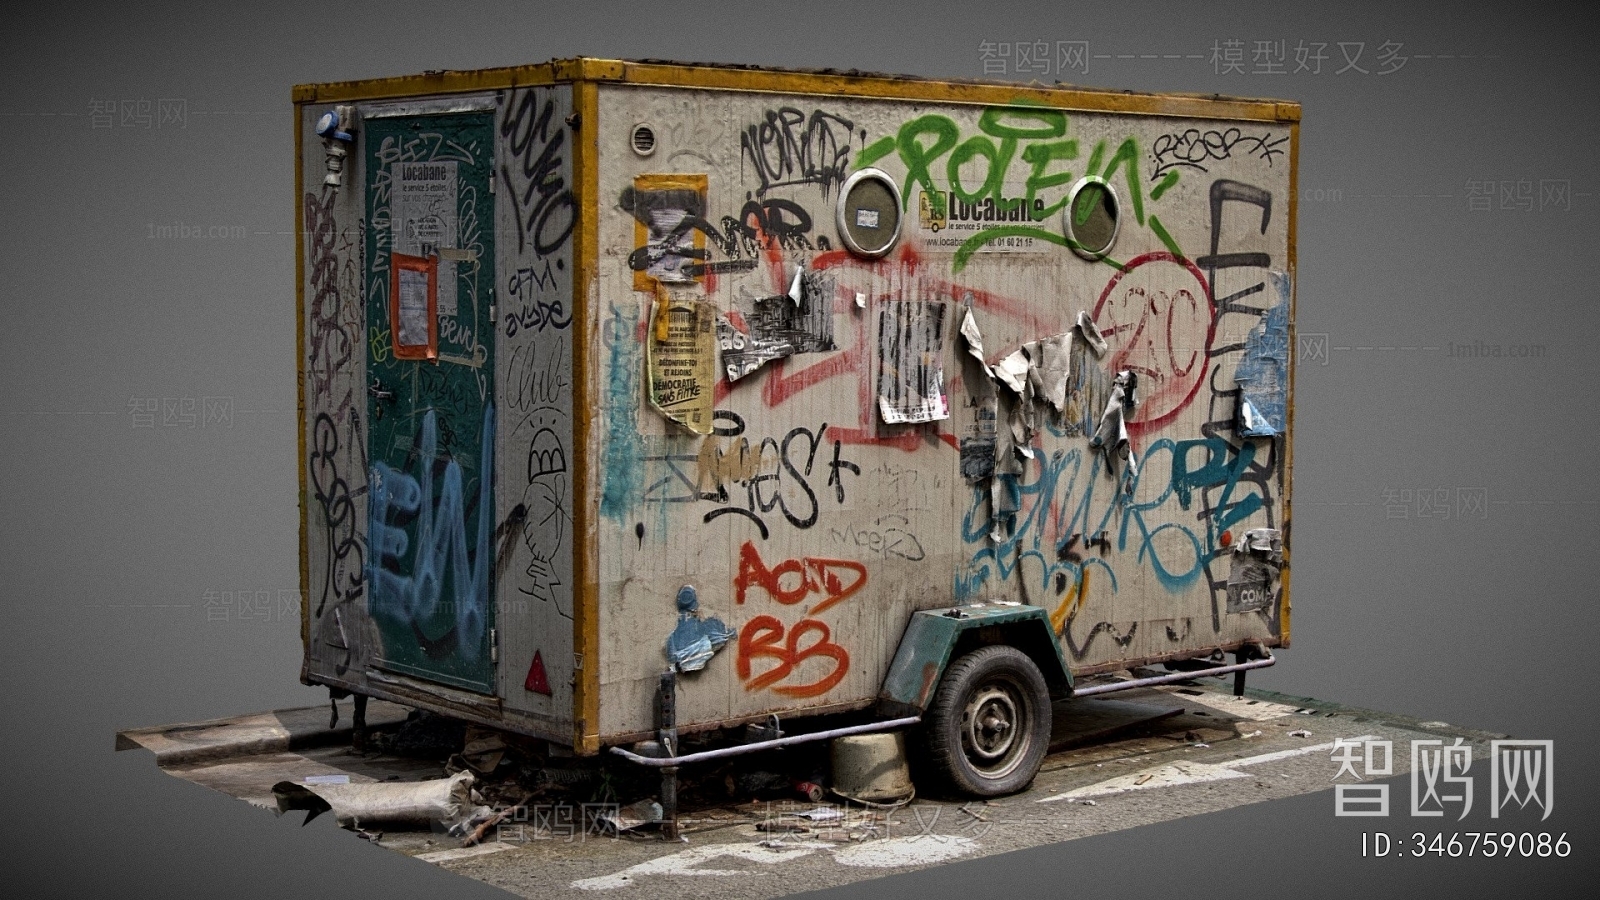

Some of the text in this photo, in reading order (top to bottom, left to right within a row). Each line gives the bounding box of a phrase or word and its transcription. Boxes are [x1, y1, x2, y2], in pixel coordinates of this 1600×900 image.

[402, 164, 447, 181] Locabane
[949, 191, 1045, 222] Locabane
[997, 237, 1005, 247] 01
